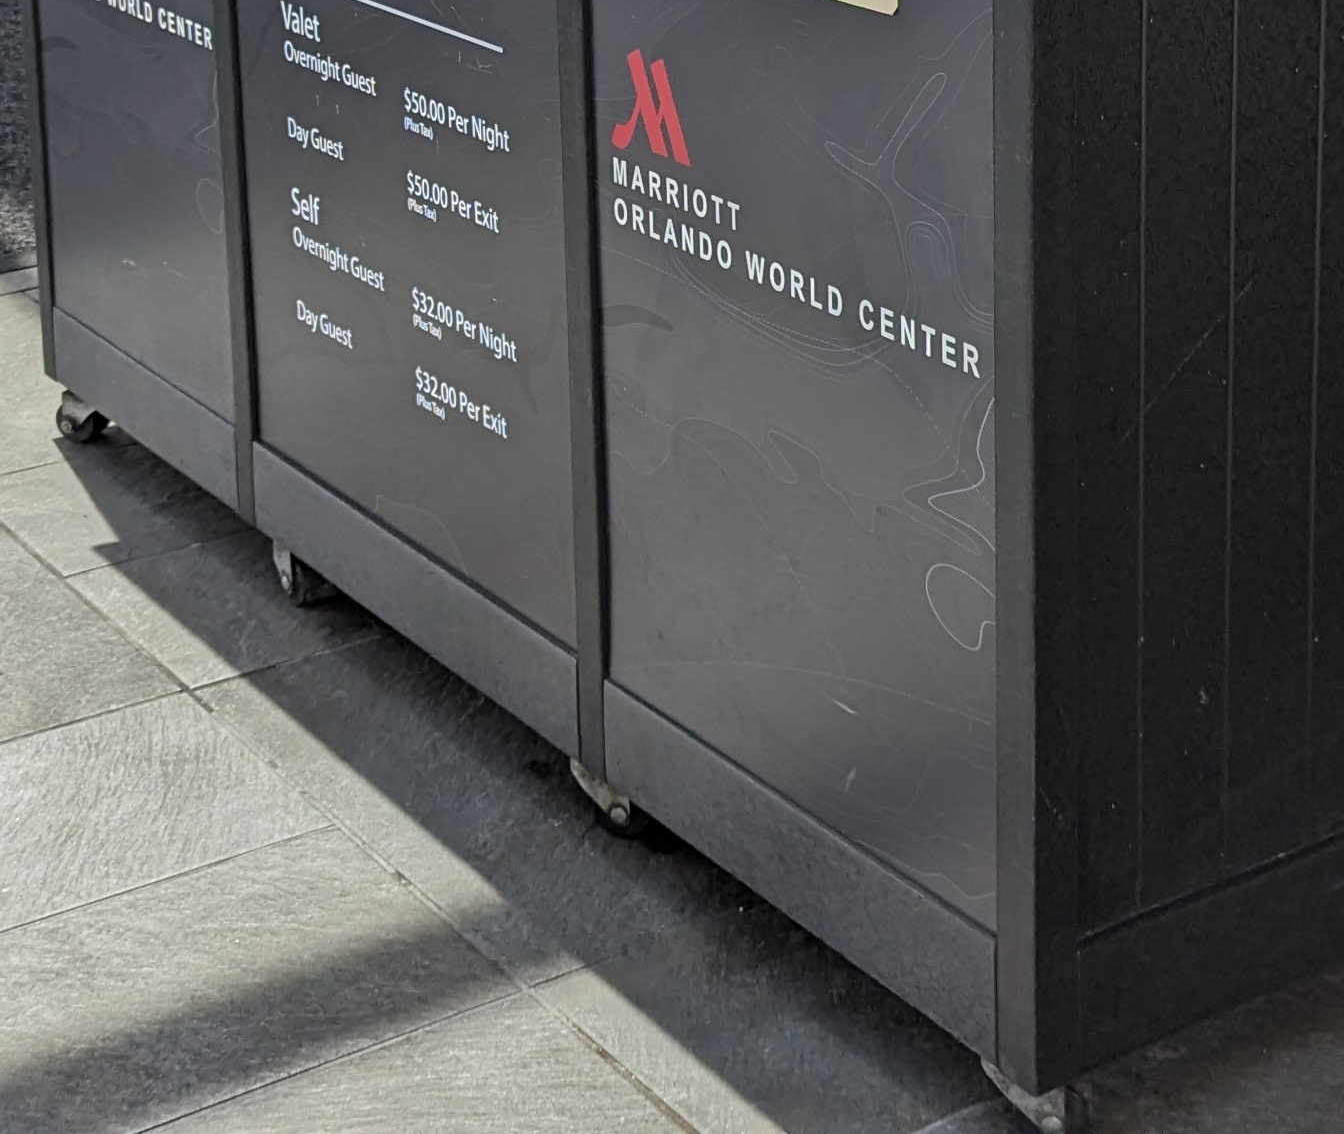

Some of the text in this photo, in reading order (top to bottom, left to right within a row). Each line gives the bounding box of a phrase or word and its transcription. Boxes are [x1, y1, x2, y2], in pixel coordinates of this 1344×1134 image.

[157, 7, 213, 50] CENTER
[280, 0, 321, 43] Valet
[284, 40, 377, 97] Overnight Guest
[286, 116, 344, 161] Day Guest
[404, 87, 510, 153] $50.00 Per Night
[404, 116, 434, 141] (Plus Tax)
[291, 187, 320, 225] Self
[407, 169, 500, 234] $50.00 Per Exit
[408, 197, 437, 222] (Plus Tax)
[612, 156, 740, 232] MARRIOTT
[292, 226, 385, 292] Overnight Guest
[614, 197, 981, 379] ORLANDO WORLD CENTER
[296, 299, 353, 349] Day Guest
[412, 286, 517, 363] $32.00 Per Night
[413, 313, 442, 340] (Plus Tax)
[415, 366, 508, 439] $32.00 Per Exit
[416, 393, 446, 420] (Plus Tax)
